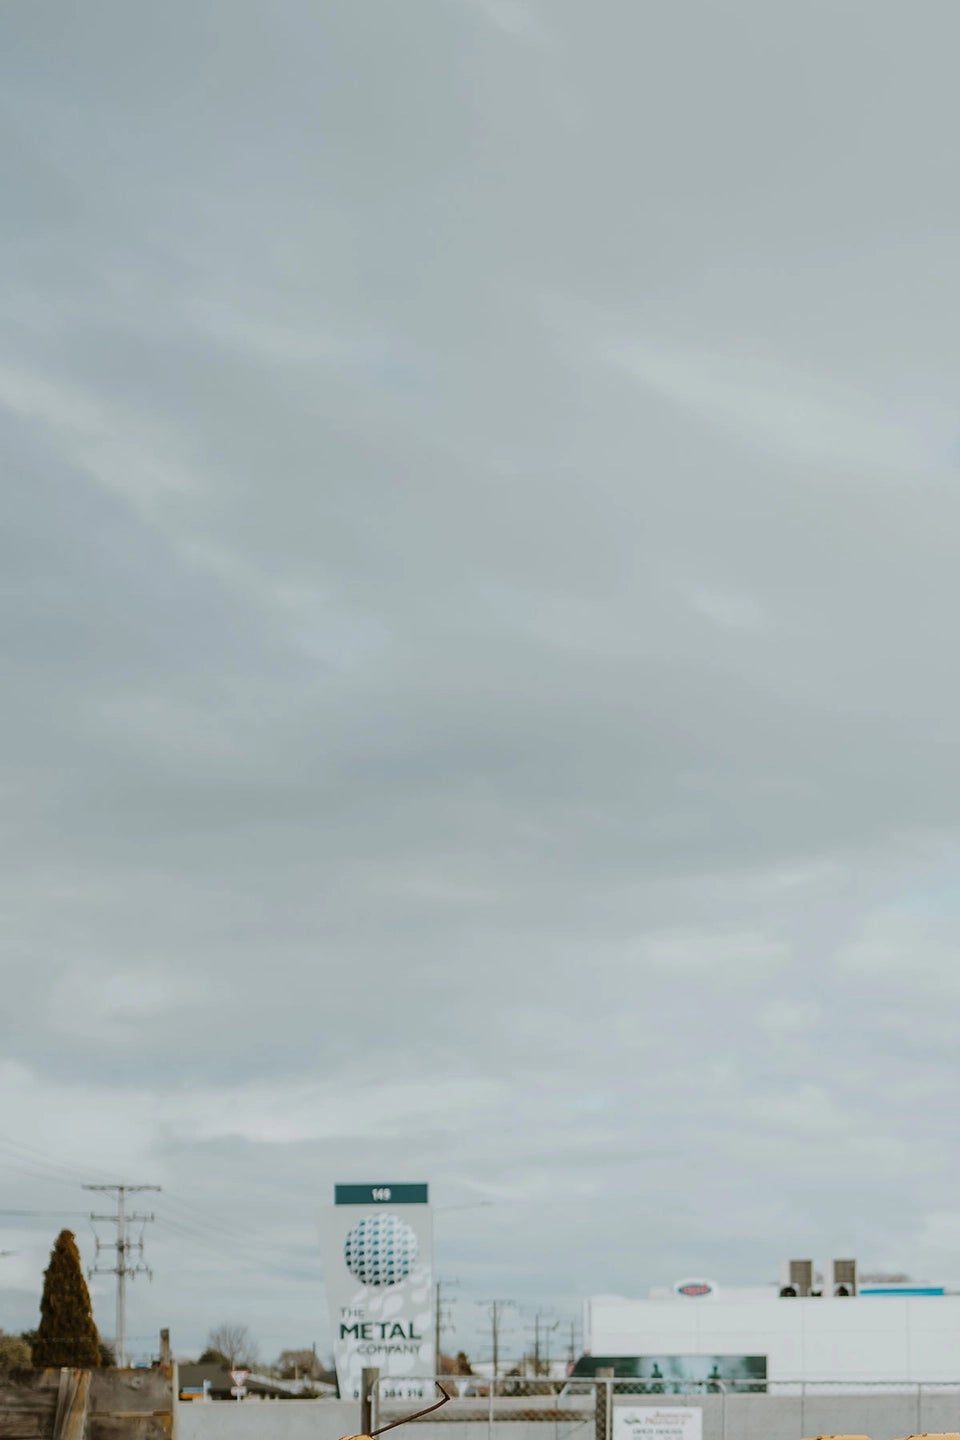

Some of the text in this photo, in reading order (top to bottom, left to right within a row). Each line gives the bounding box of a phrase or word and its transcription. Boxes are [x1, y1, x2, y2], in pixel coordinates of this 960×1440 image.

[340, 1307, 365, 1318] THE
[340, 1322, 422, 1340] METAL
[356, 1343, 421, 1355] COMPANY
